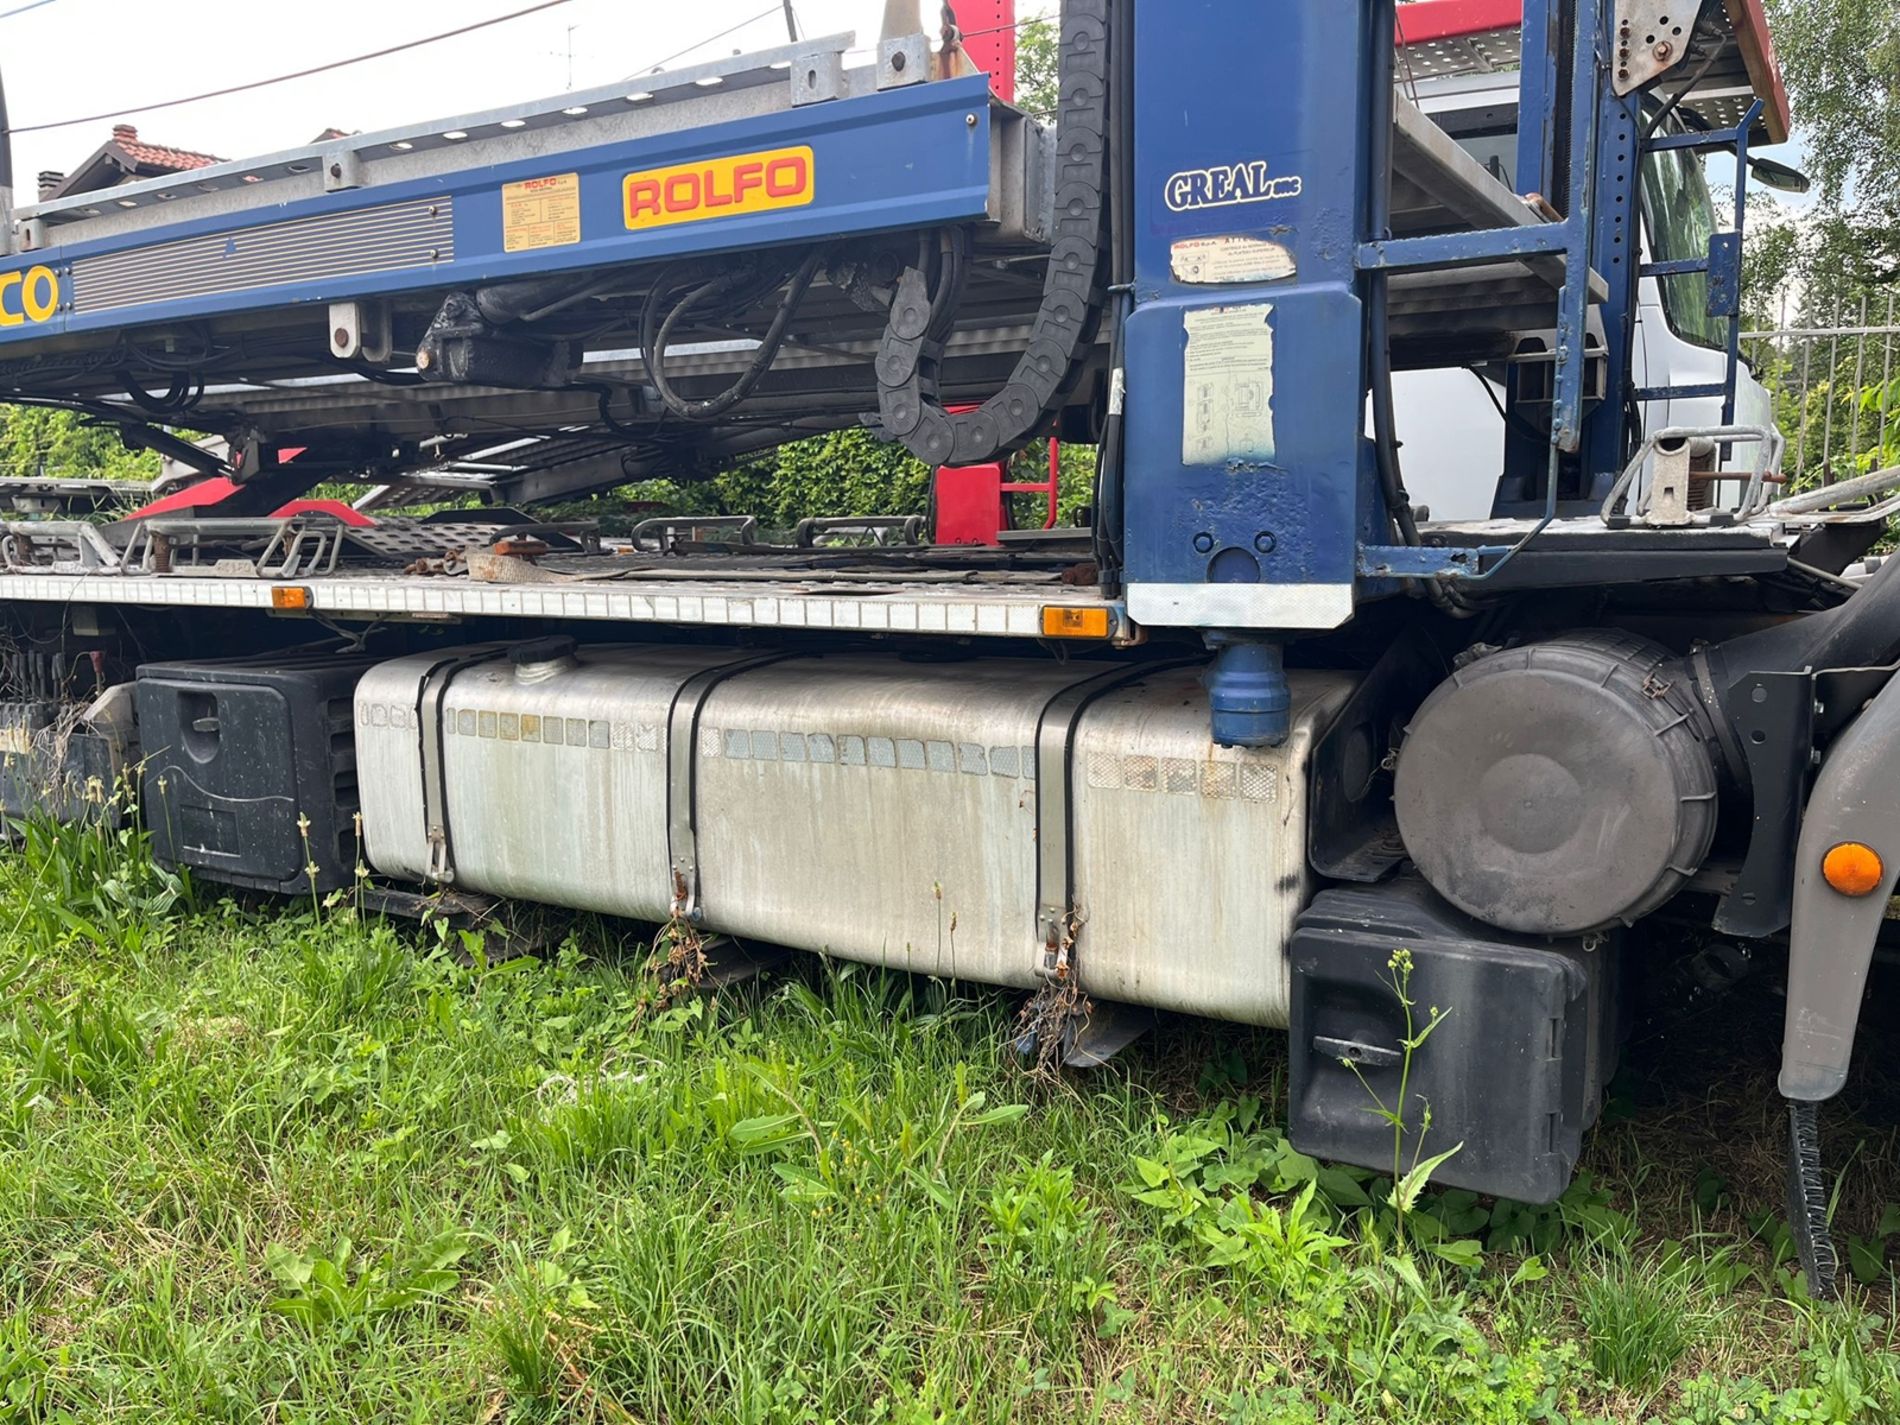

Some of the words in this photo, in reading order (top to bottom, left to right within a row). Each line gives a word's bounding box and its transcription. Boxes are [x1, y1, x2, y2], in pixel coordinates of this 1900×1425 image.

[524, 178, 556, 190] ROLFO
[629, 156, 807, 218] ROLFO
[1165, 161, 1271, 211] GREAL
